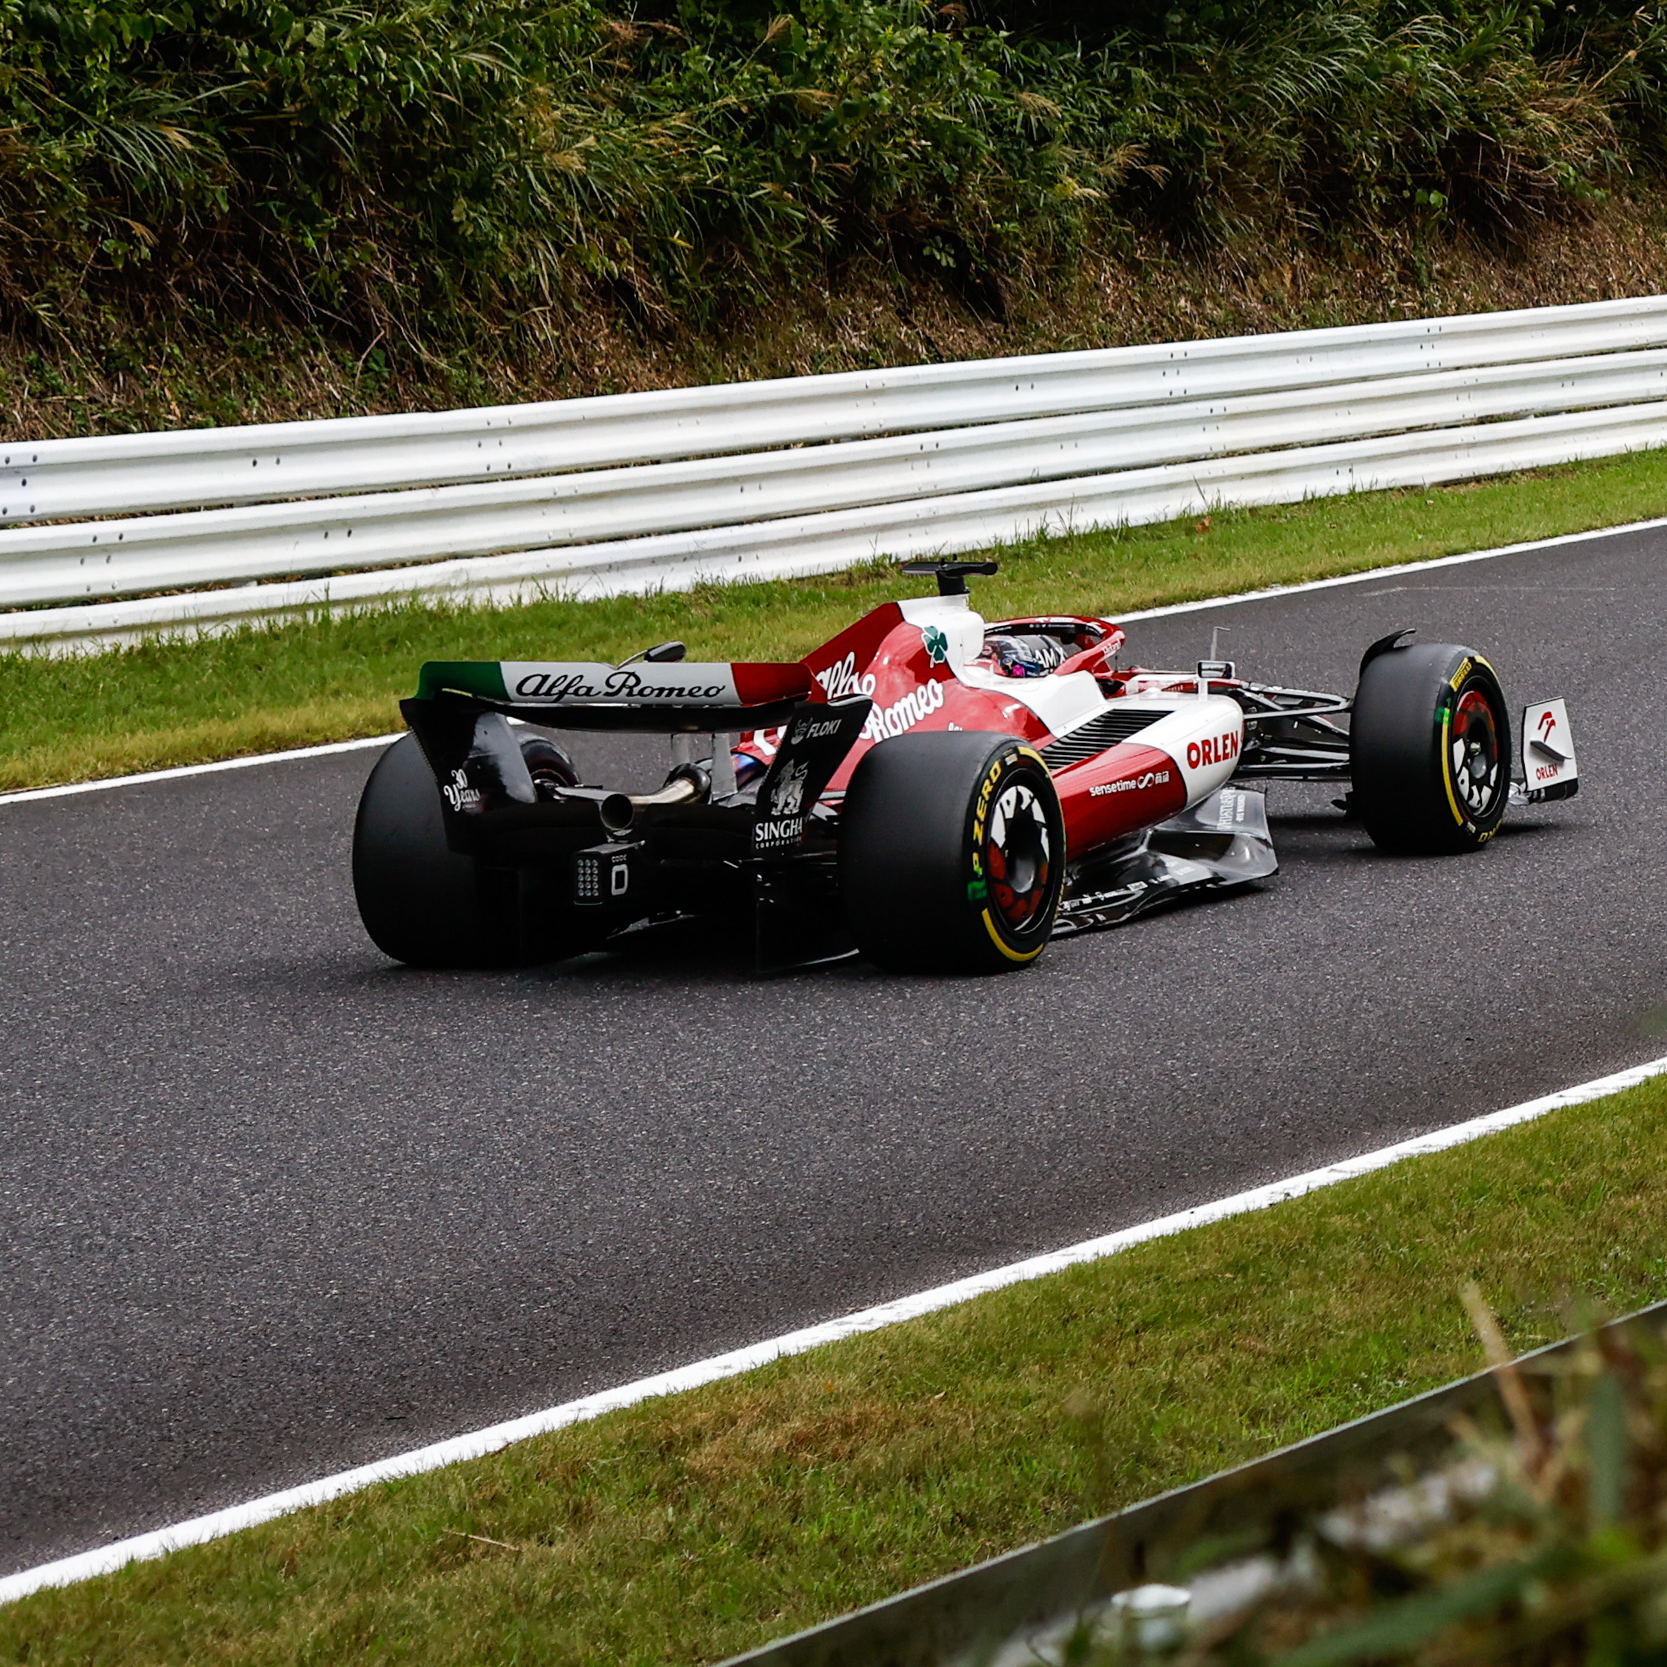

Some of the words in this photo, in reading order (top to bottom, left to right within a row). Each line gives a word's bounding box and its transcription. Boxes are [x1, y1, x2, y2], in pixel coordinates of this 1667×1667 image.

[515, 673, 602, 703] Alfa
[602, 671, 726, 698] Romeo
[805, 719, 842, 739] FLOKI
[1186, 730, 1239, 770] ORLEN
[450, 768, 468, 789] 30
[1536, 764, 1558, 780] ORLEN
[1088, 779, 1137, 797] sensetime
[973, 760, 1002, 847] ZERO
